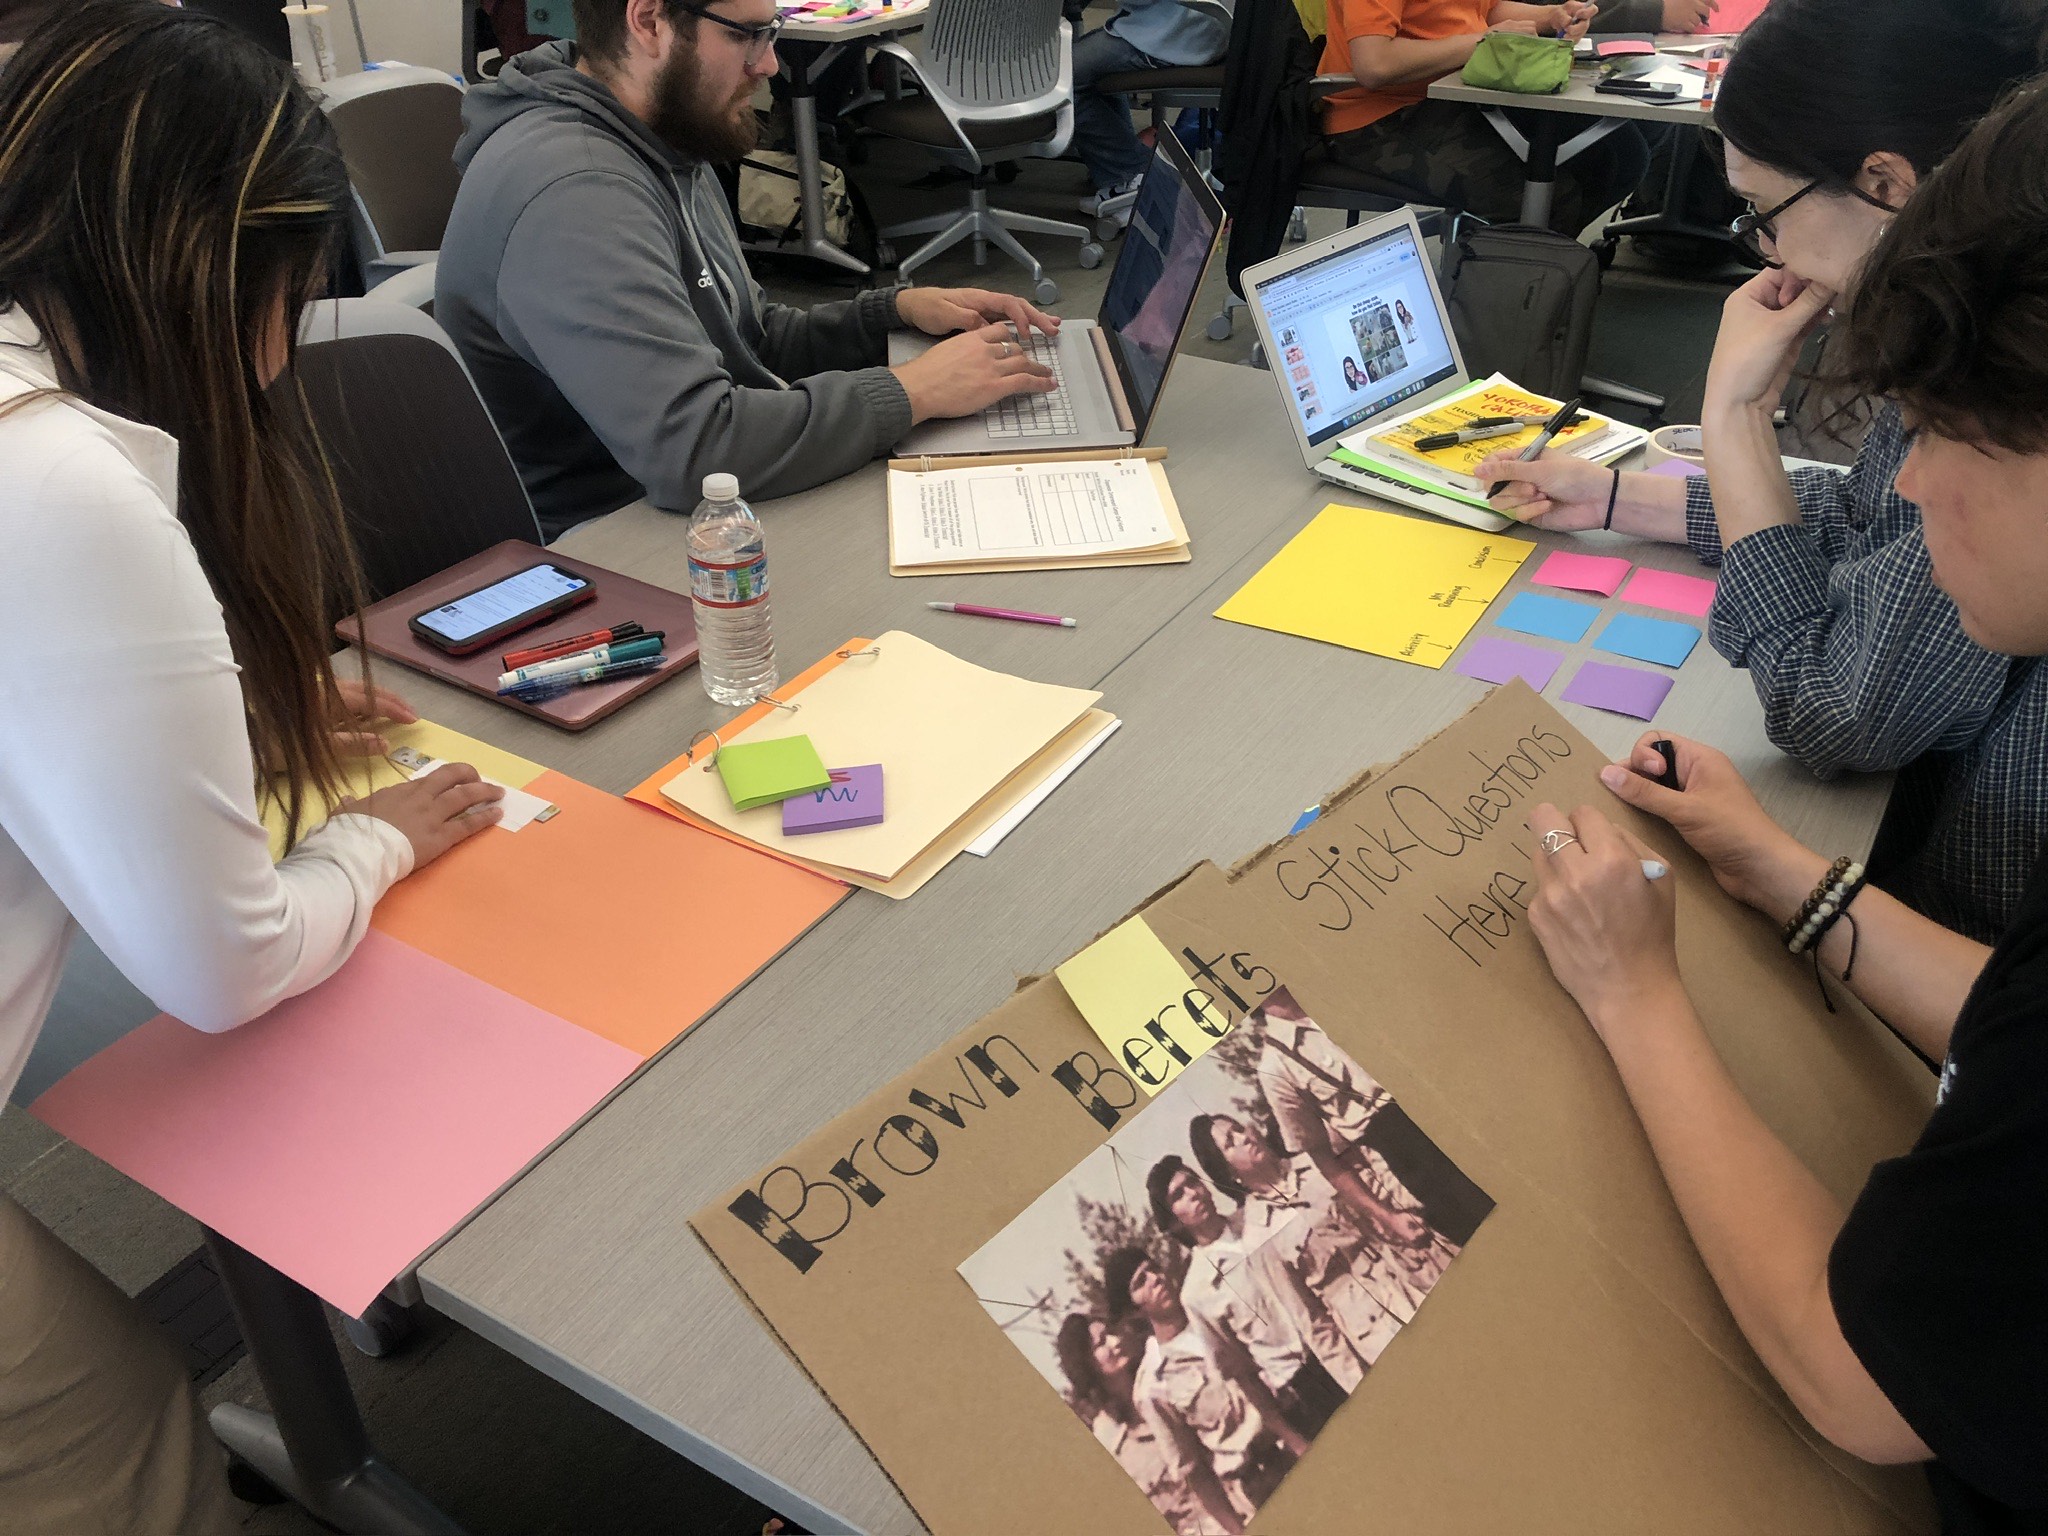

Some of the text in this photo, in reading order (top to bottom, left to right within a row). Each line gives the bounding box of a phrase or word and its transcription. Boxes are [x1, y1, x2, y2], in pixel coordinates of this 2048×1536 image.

[1399, 633, 1430, 657] Activity
[1277, 725, 1571, 931] Stick Questions
[727, 946, 1277, 1274] Brown Berets
